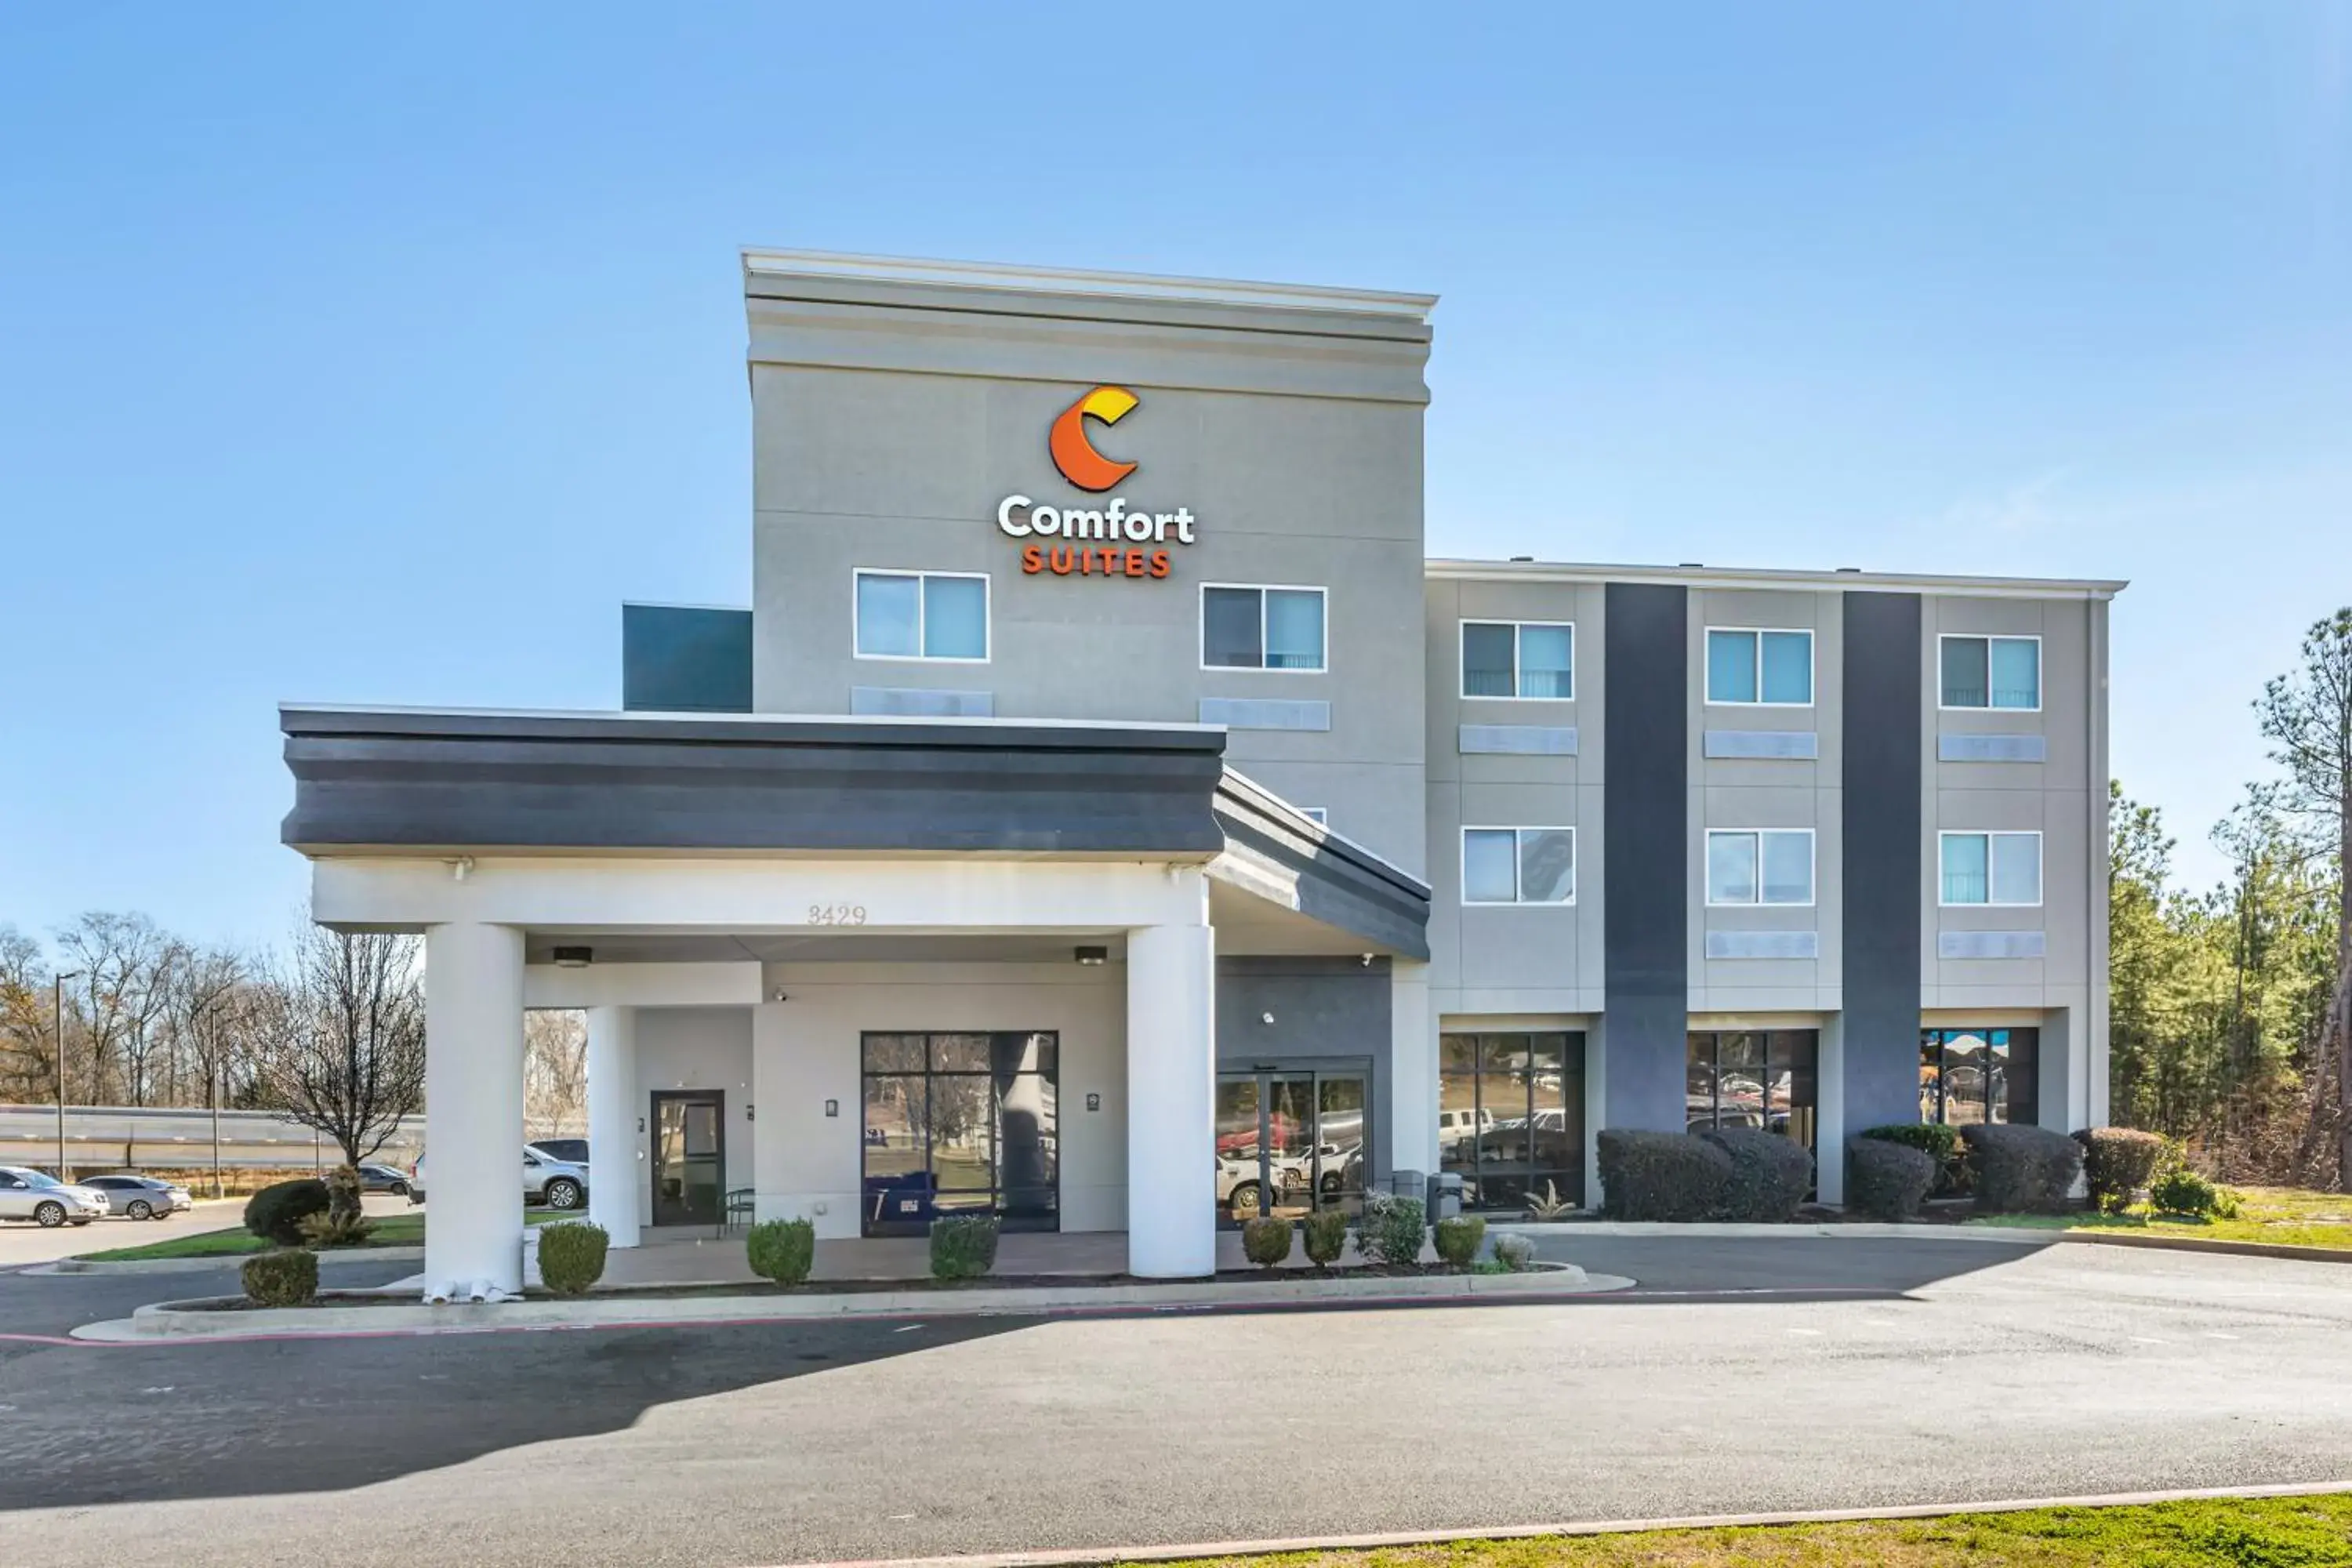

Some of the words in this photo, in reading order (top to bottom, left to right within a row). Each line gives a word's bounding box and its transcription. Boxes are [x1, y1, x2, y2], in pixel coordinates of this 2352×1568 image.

[997, 495, 1195, 543] Comfort
[1022, 544, 1171, 579] SUITES
[807, 903, 866, 926] 3429
